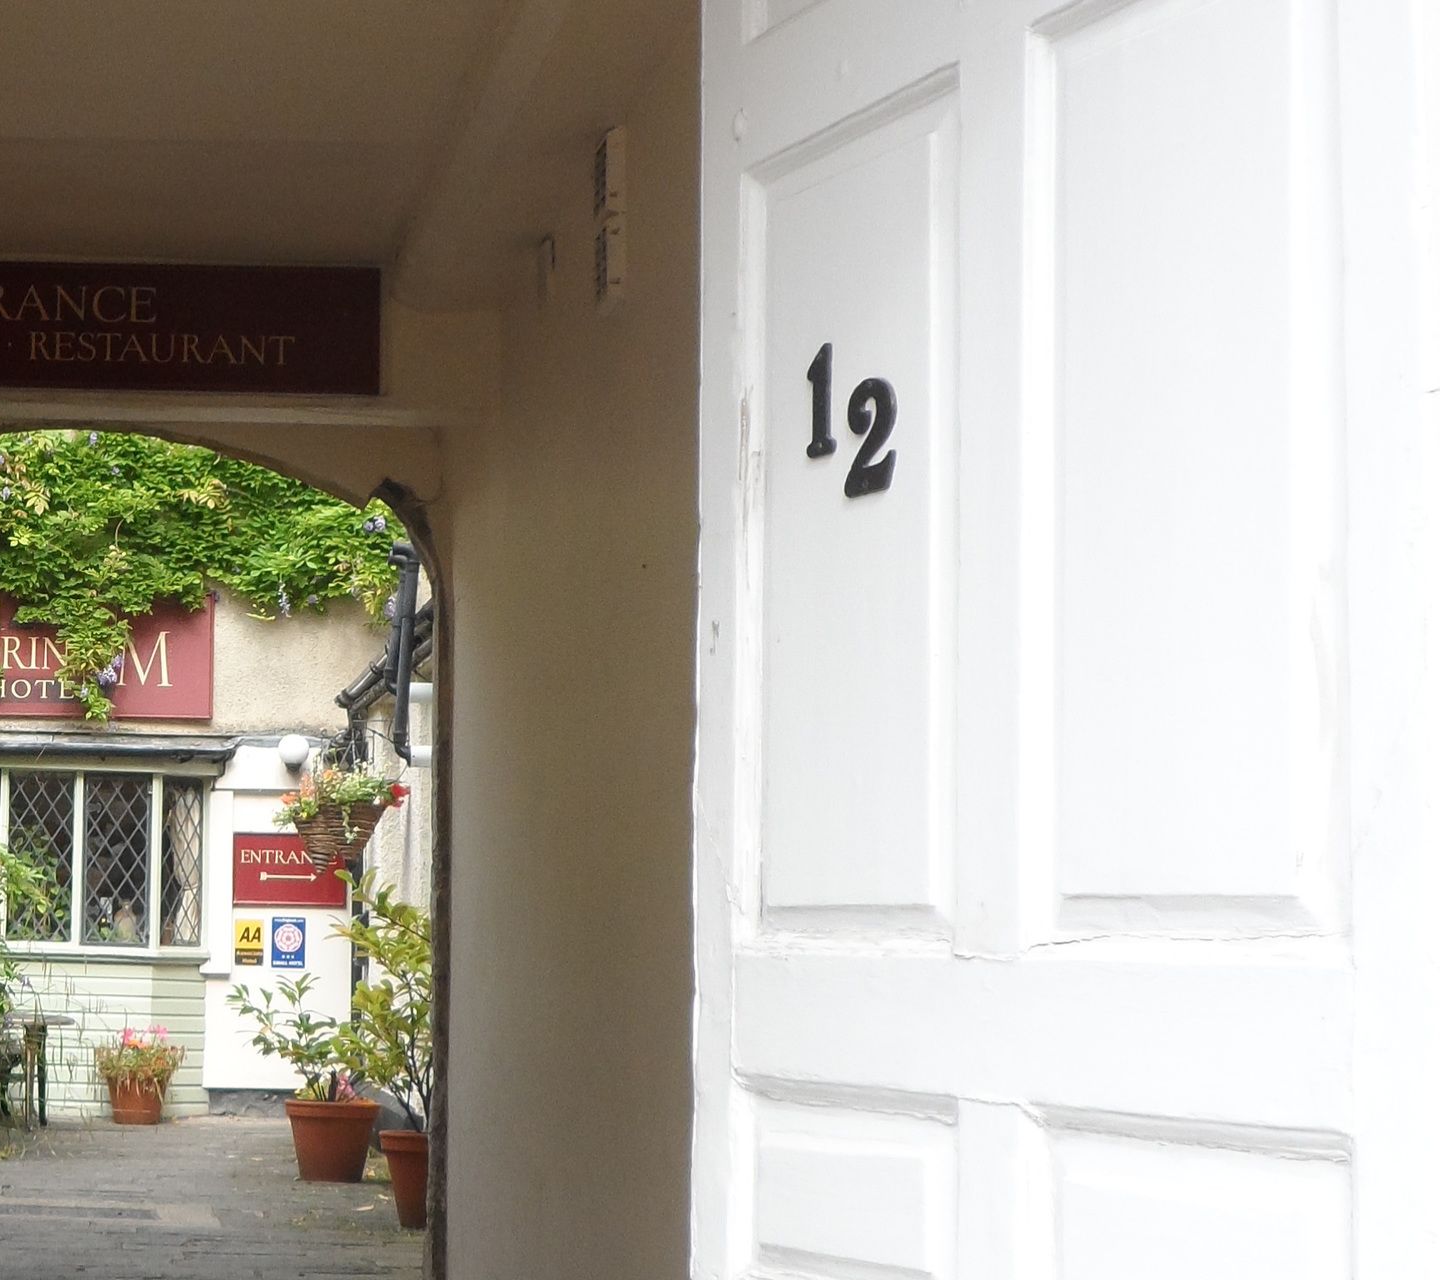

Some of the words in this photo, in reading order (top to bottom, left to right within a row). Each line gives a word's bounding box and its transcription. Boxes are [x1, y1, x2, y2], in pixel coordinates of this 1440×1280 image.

[29, 330, 296, 366] RESTAURANT
[806, 342, 899, 499] 12
[0, 678, 76, 700] OTE
[240, 848, 338, 865] ENTRAN
[239, 926, 262, 943] AA
